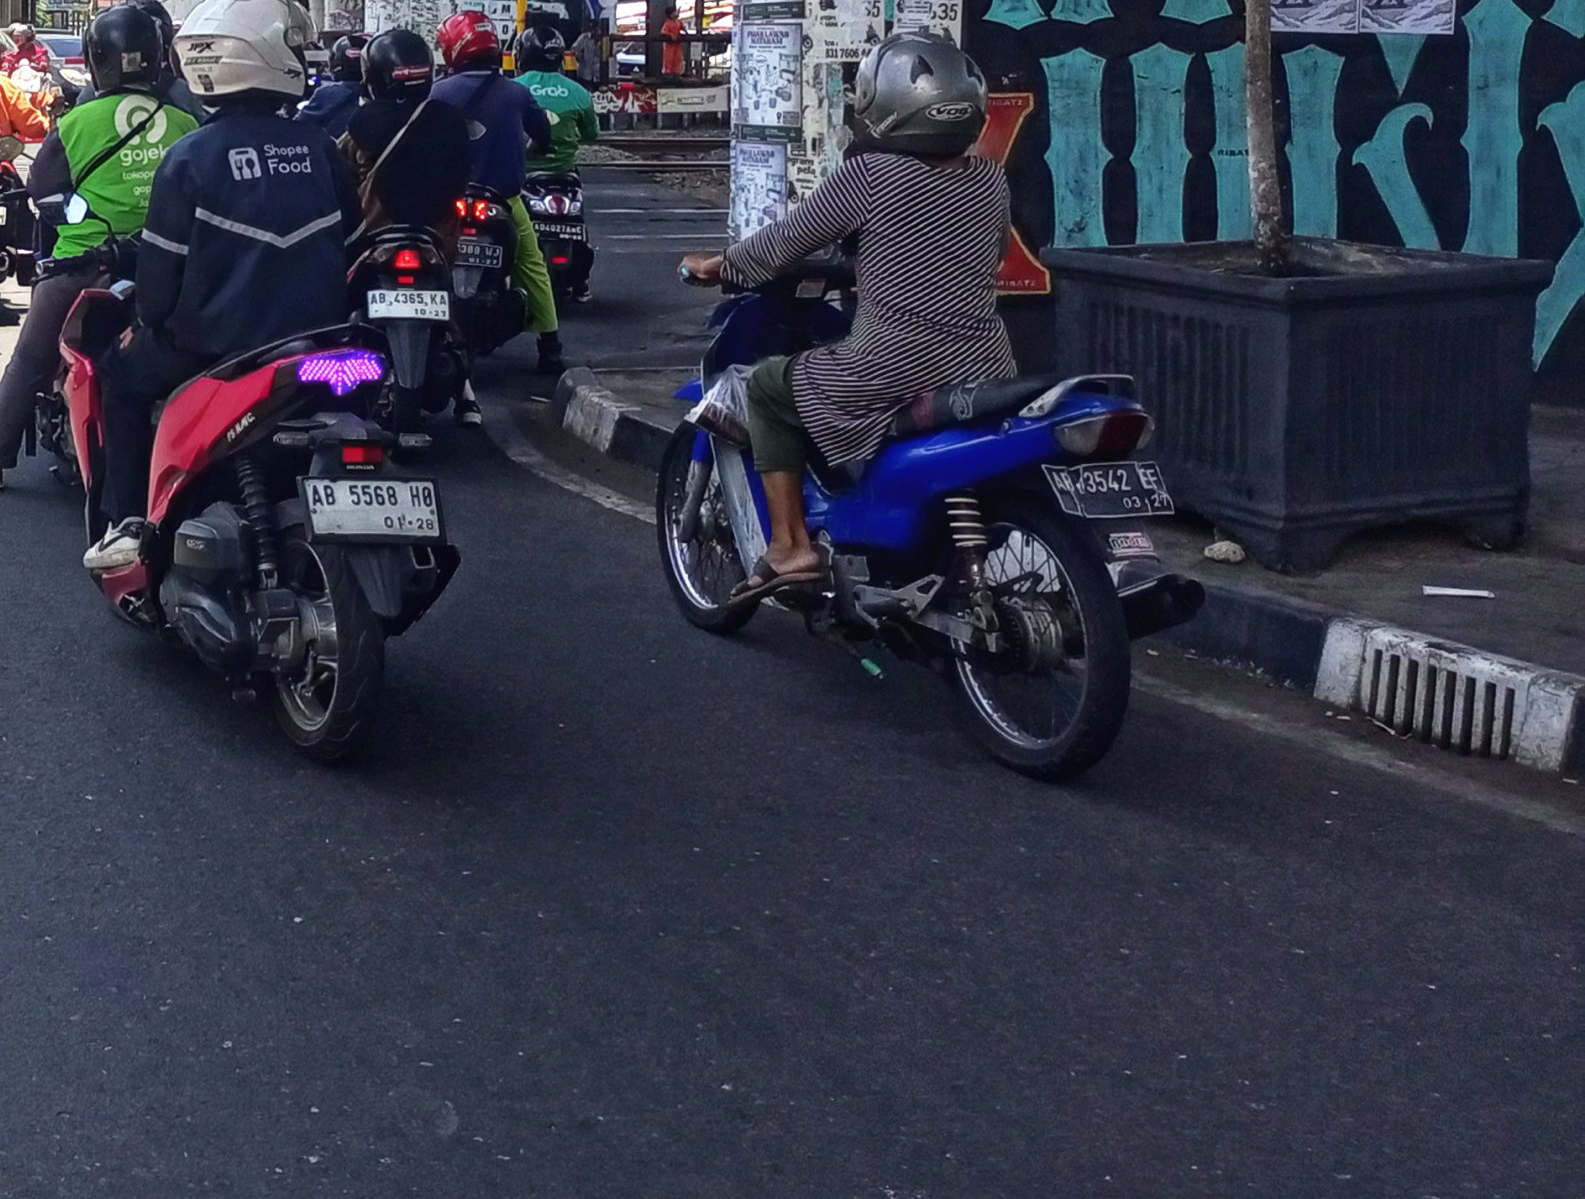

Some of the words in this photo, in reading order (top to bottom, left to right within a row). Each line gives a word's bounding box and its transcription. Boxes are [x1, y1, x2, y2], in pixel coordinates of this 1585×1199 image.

[529, 84, 569, 97] Grab
[263, 144, 309, 159] Shopee
[267, 158, 312, 176] Food
[370, 293, 386, 305] AB
[394, 293, 425, 306] 4365
[430, 293, 448, 306] KA
[1052, 471, 1075, 493] AB
[1082, 469, 1132, 493] 3542
[1137, 468, 1159, 491] EF
[312, 485, 335, 506] AB
[348, 485, 398, 507] 5568
